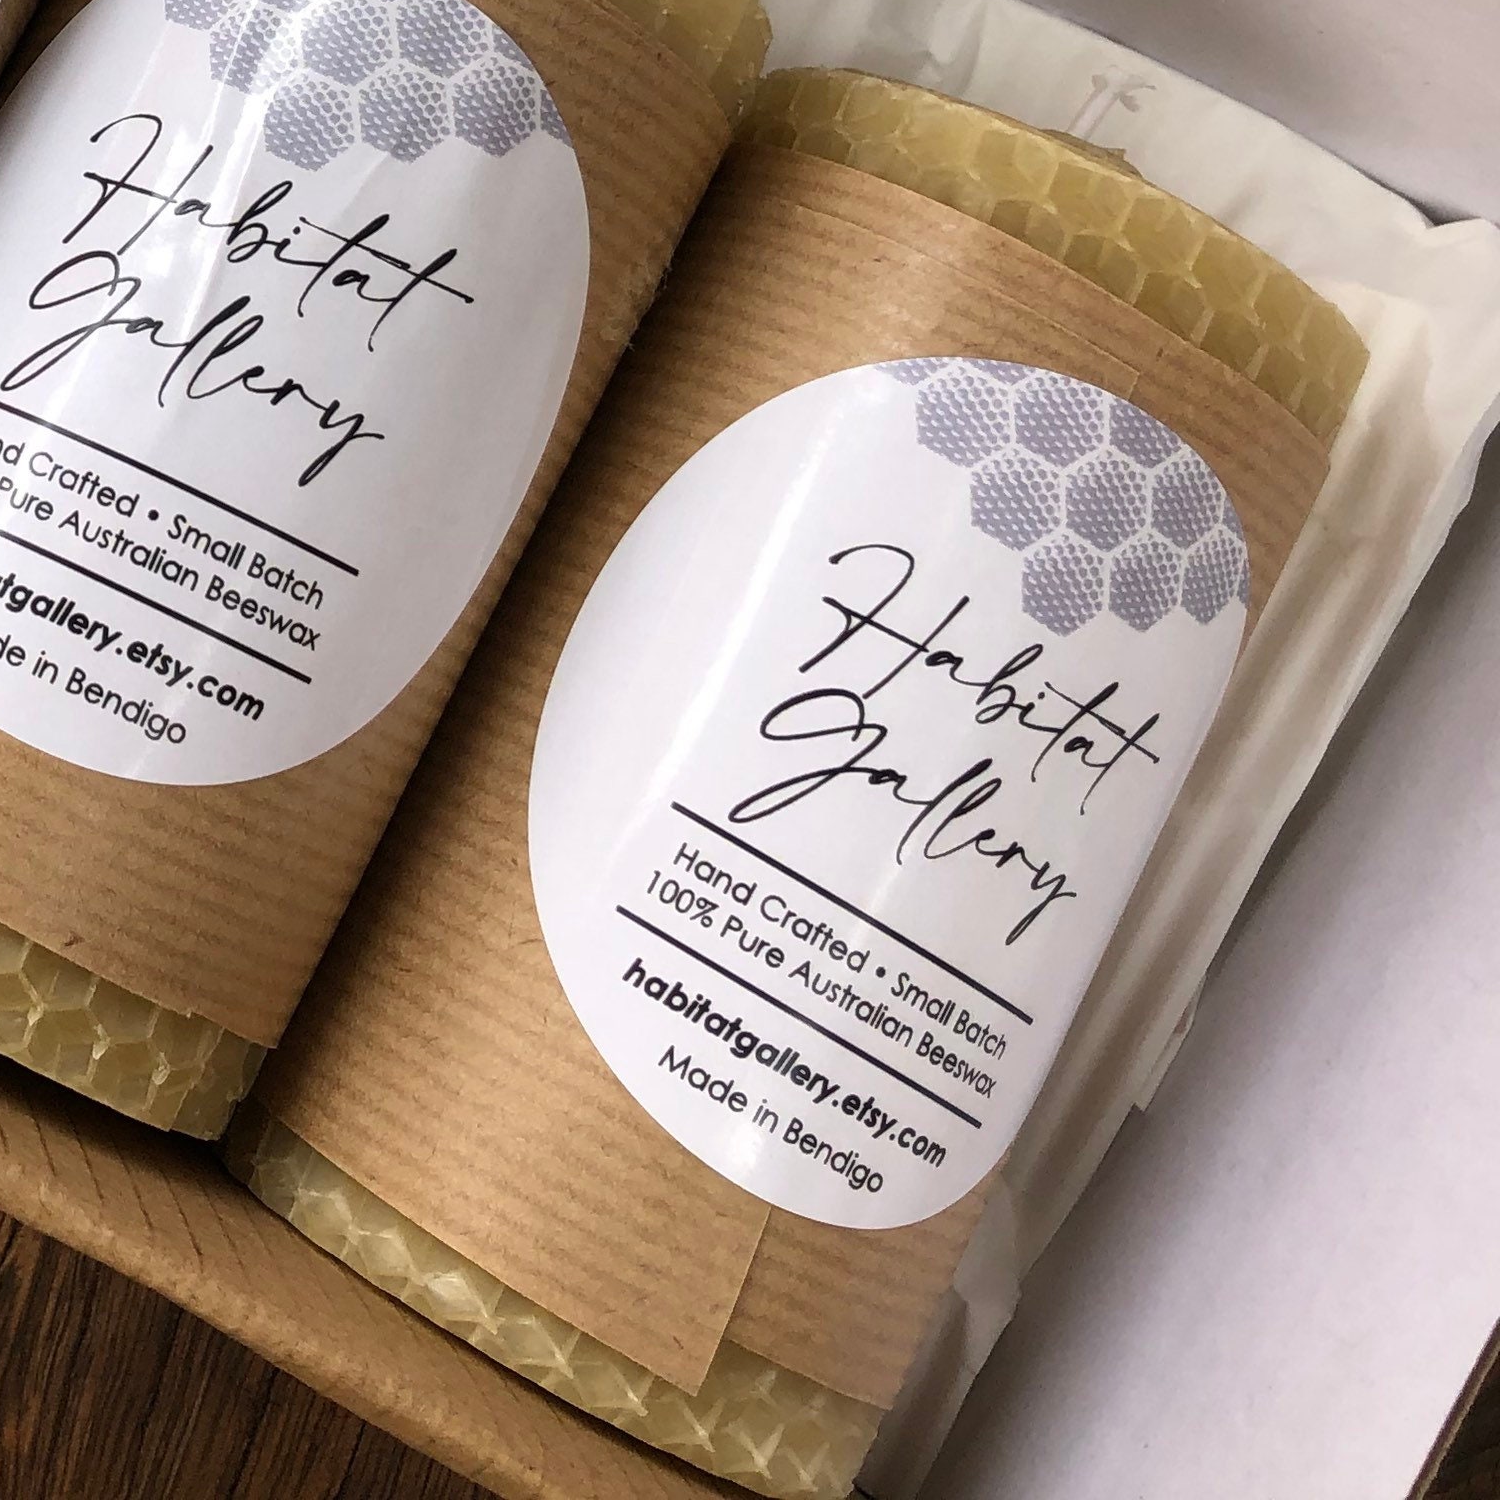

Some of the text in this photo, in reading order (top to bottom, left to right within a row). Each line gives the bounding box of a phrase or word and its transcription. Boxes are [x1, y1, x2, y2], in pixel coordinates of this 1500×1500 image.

[63, 113, 474, 352] Habitat
[0, 250, 384, 487] Gallery
[28, 451, 139, 519] Crafted
[166, 512, 246, 571] Small
[247, 554, 325, 610] Batch
[58, 512, 199, 594] Australian
[204, 578, 322, 651] Beeswax
[32, 649, 61, 684] in
[65, 664, 188, 747] Bendigo
[798, 544, 1160, 816] Habitat
[729, 688, 1077, 946] Gallery
[644, 869, 997, 1100] 100% Pure Australian Beeswax
[673, 841, 1007, 1059] Hand Crafted Small Batch
[622, 958, 948, 1169] habitatgallery.etsy.com
[658, 1045, 884, 1195] Made in Bendigo
